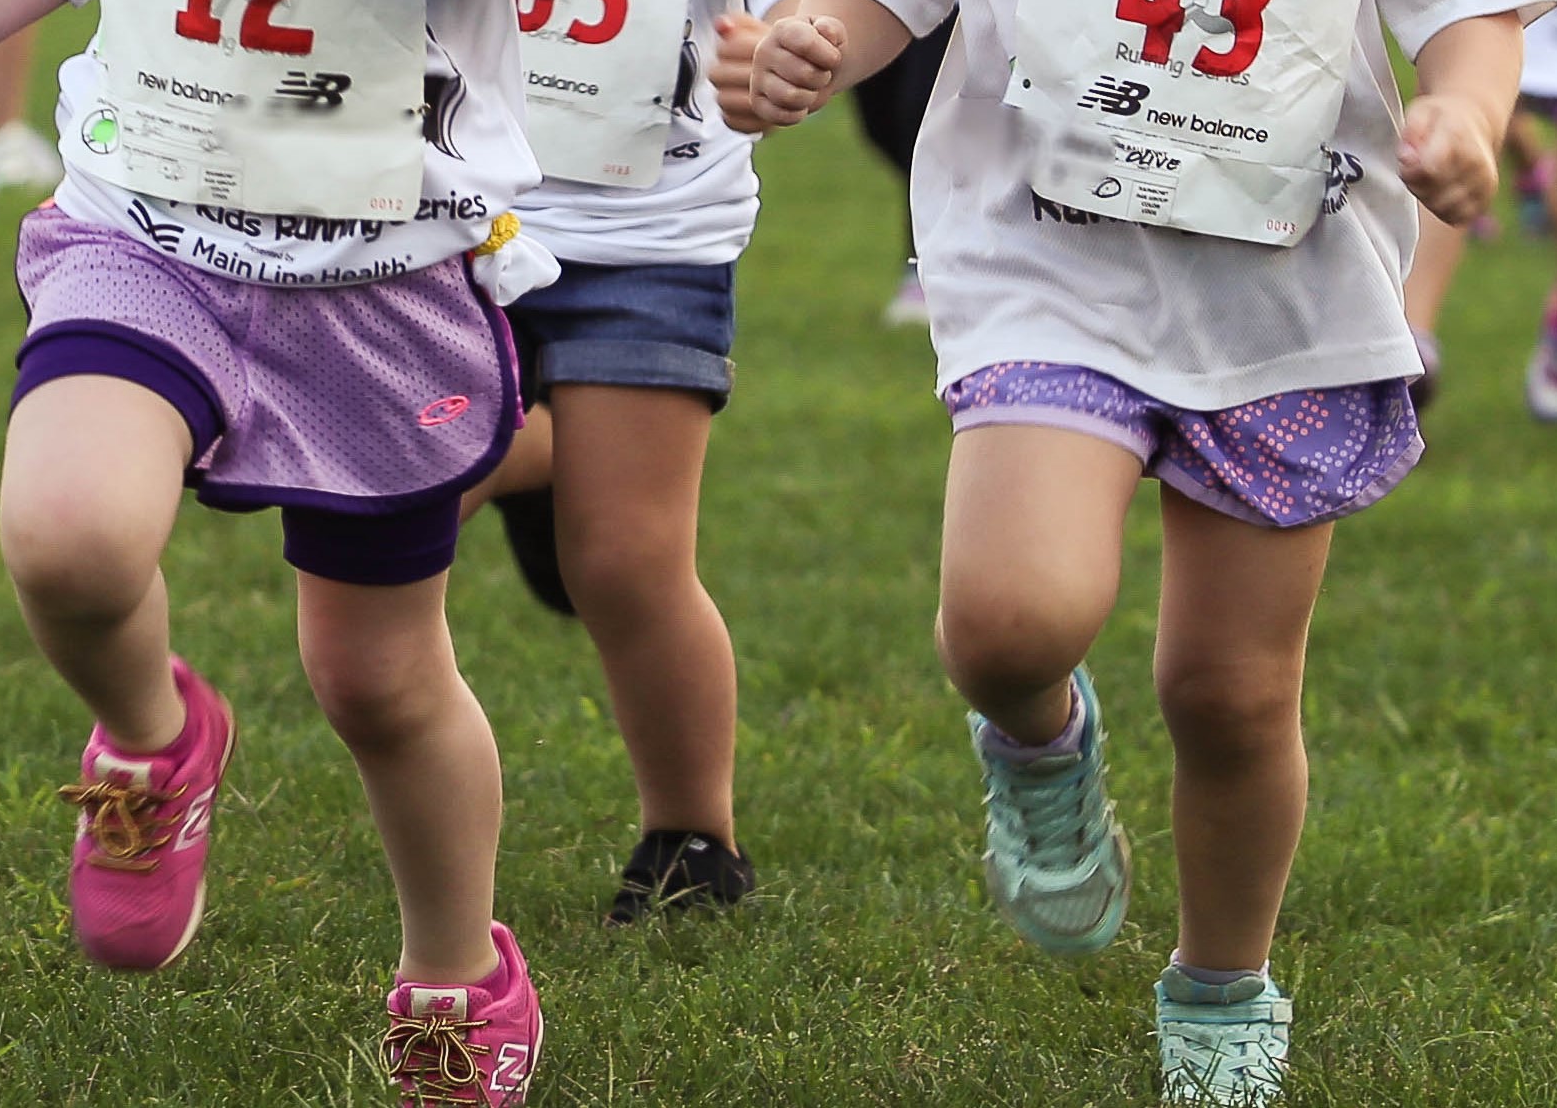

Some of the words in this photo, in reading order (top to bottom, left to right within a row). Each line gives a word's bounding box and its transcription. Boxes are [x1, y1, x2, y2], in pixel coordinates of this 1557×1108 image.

[138, 70, 169, 91] new
[171, 76, 239, 105] balanc
[528, 70, 599, 96] balance
[1147, 107, 1187, 128] new
[1190, 114, 1269, 143] balance
[193, 237, 252, 279] Main
